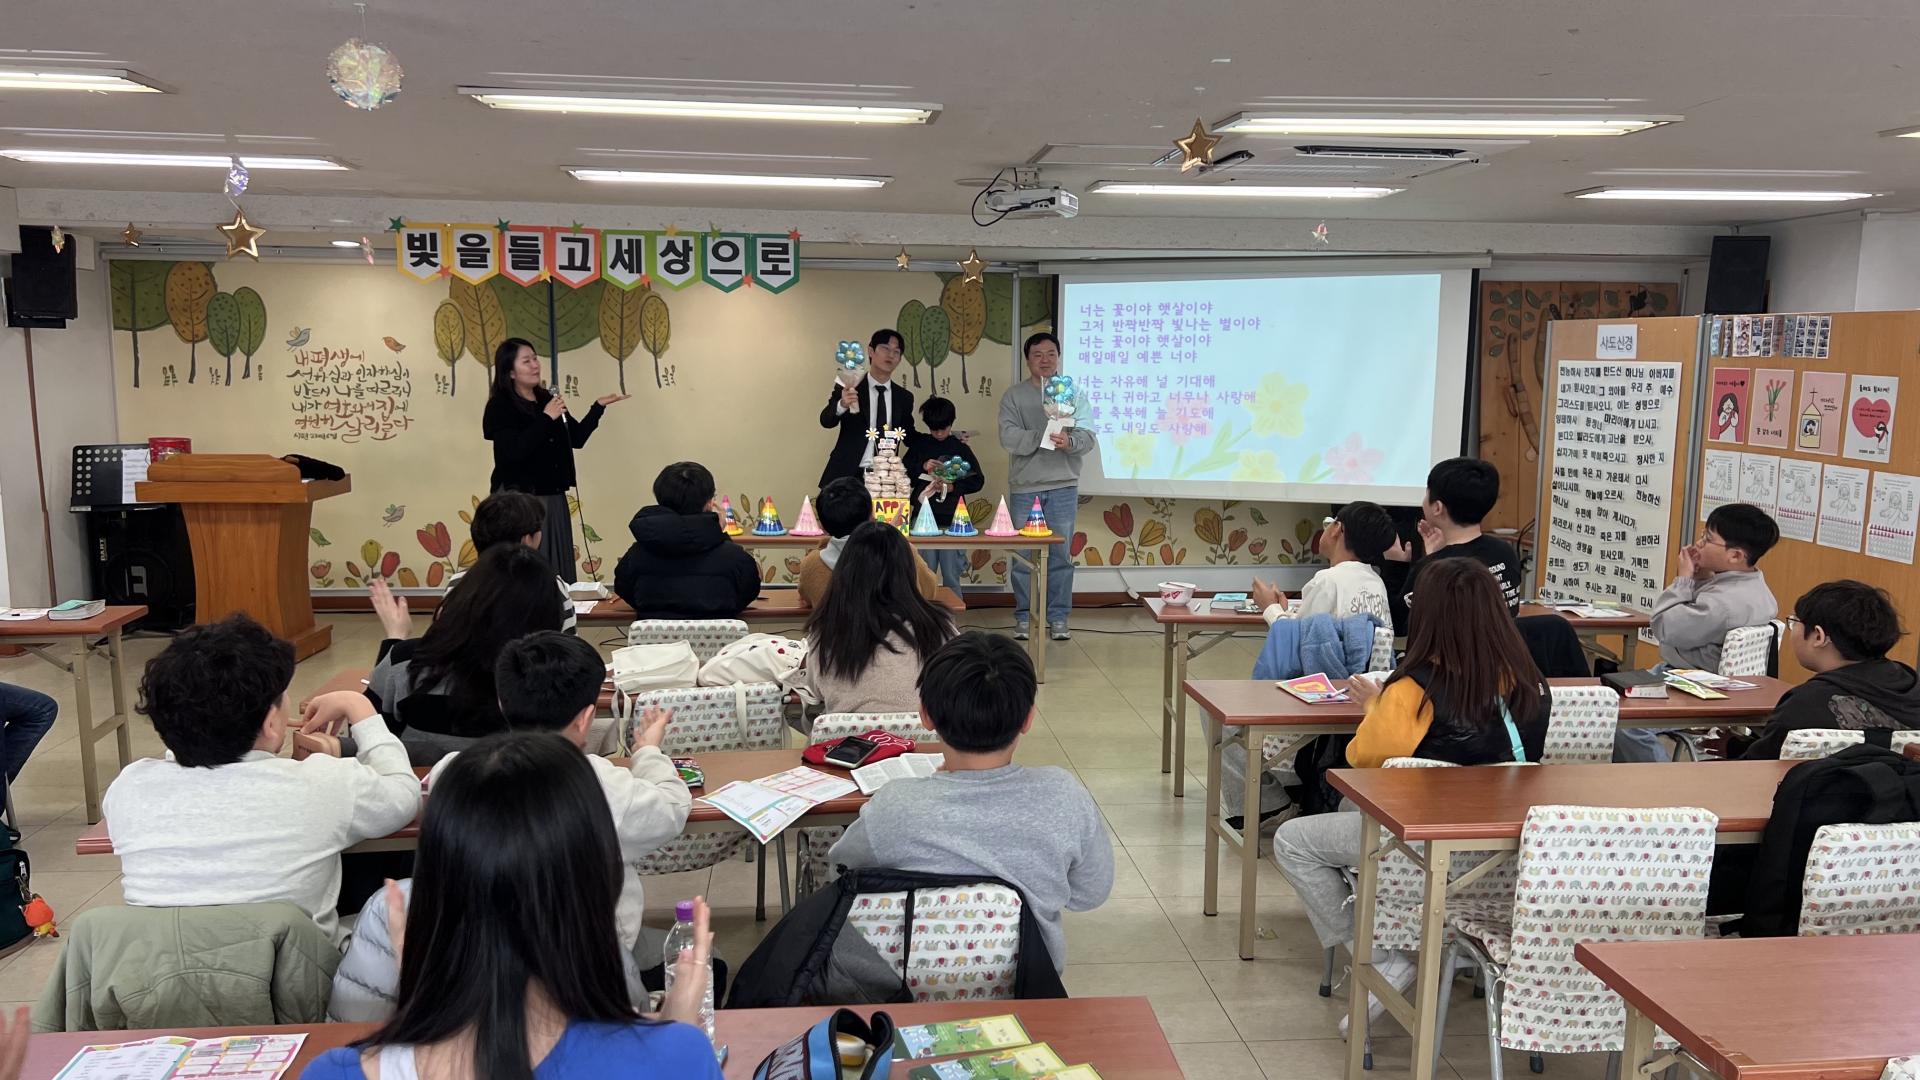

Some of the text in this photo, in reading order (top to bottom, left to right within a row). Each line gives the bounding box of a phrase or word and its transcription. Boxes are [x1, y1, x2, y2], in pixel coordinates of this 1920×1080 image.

[1080, 301, 1213, 317] 너는 꽃이야 햇살이야
[1079, 317, 1261, 332] 그저 반짝반짝 빛나는 별이야
[1079, 333, 1212, 348] 너는 꽃이야 햇살이야
[1600, 335, 1633, 352] 사도신경
[1078, 350, 1198, 364] 매일매일 예쁜 너야
[1560, 367, 1581, 377] 전능하사
[1603, 366, 1622, 377] 만드신
[1625, 368, 1644, 379] 하나님
[1649, 368, 1675, 379] 아버지를
[1156, 375, 1168, 388] 널
[1176, 374, 1216, 388] 기대해
[1560, 383, 1572, 393] 내가
[1630, 382, 1643, 393] 우리
[1660, 385, 1673, 396] 예수
[1123, 391, 1161, 405] 귀하고
[1617, 400, 1630, 410] 이는
[1635, 399, 1660, 410] 성령으로
[1155, 406, 1169, 420] 늘
[1604, 413, 1636, 429] 마리아에게
[1121, 422, 1161, 436] 내일도
[1608, 434, 1626, 445] 고난을
[1582, 468, 1593, 478] 죽은
[1636, 474, 1648, 485] 다시
[1636, 489, 1660, 506] 전능하신
[1552, 495, 1569, 509] 하나님
[1575, 507, 1592, 519] 우편에
[1600, 531, 1612, 542] 죽은
[1572, 561, 1590, 572] 성도가
[1595, 563, 1607, 575] 서로
[1585, 581, 1602, 593] 주시는
